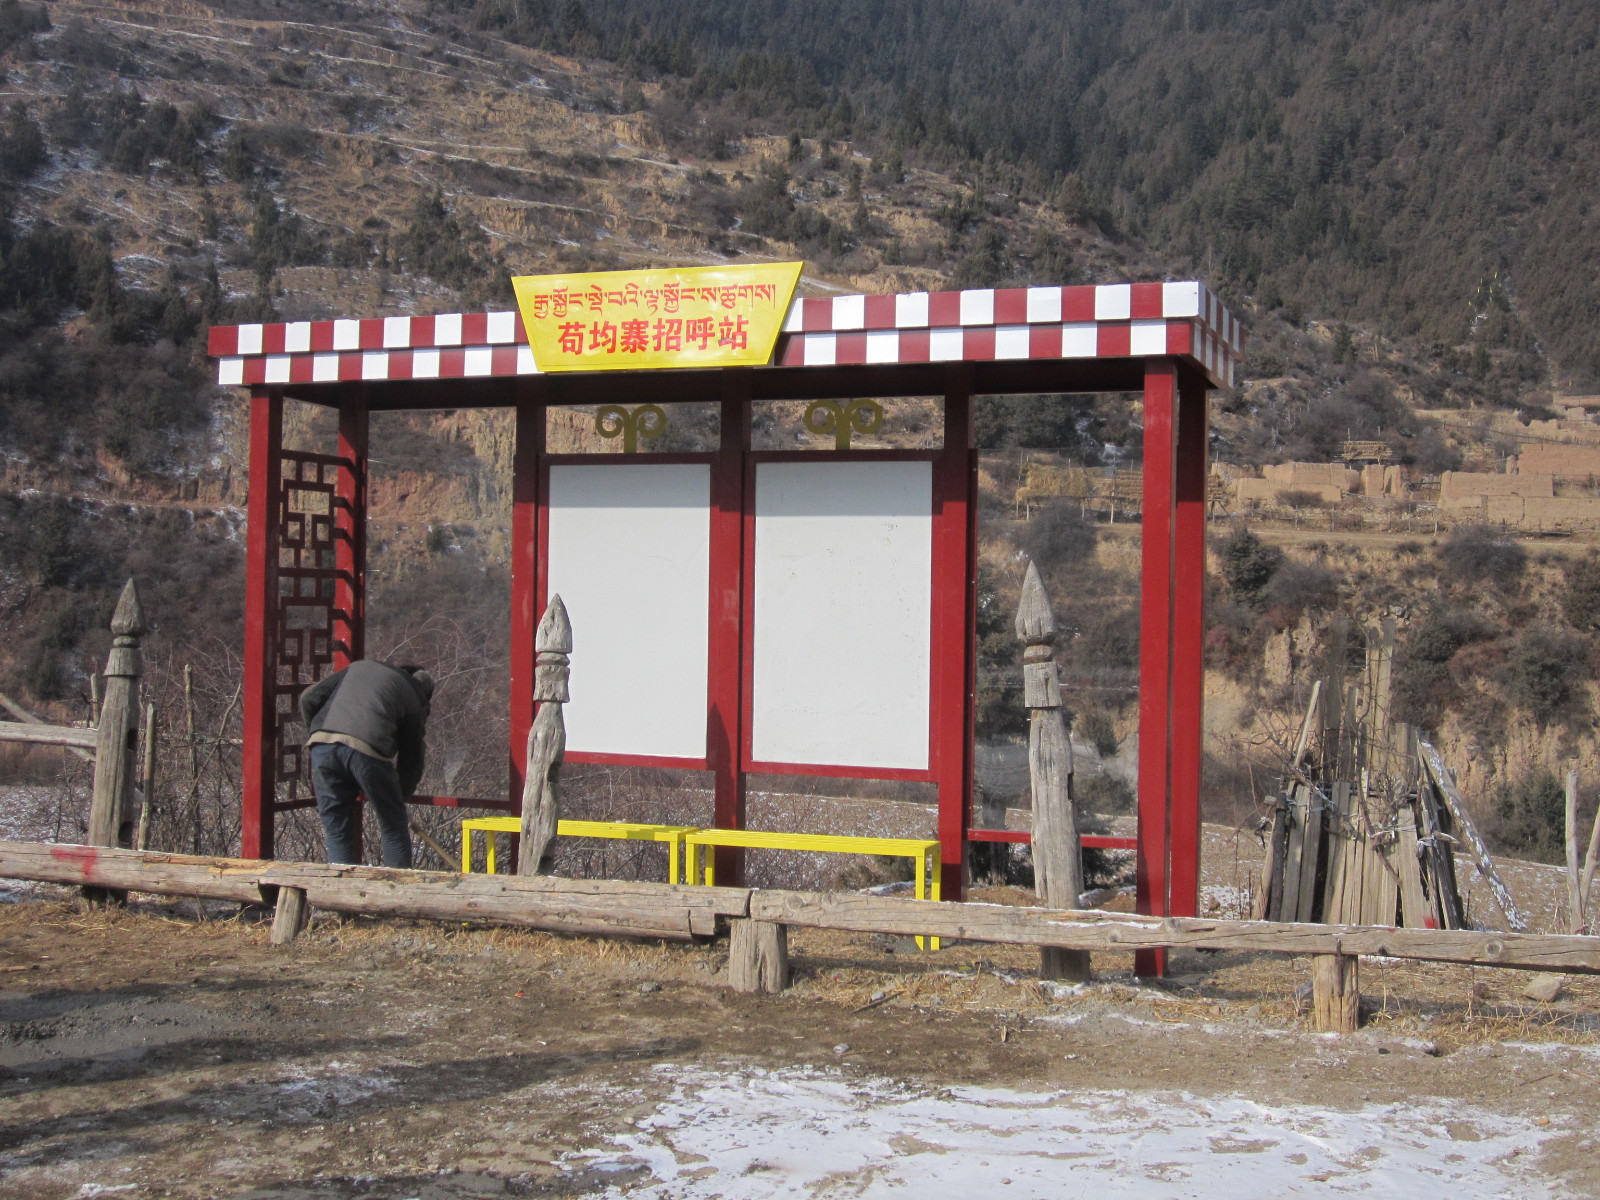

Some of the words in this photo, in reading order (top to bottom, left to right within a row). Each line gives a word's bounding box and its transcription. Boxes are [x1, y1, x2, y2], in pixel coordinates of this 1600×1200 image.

[557, 315, 750, 356] 苟均寨招呼站
